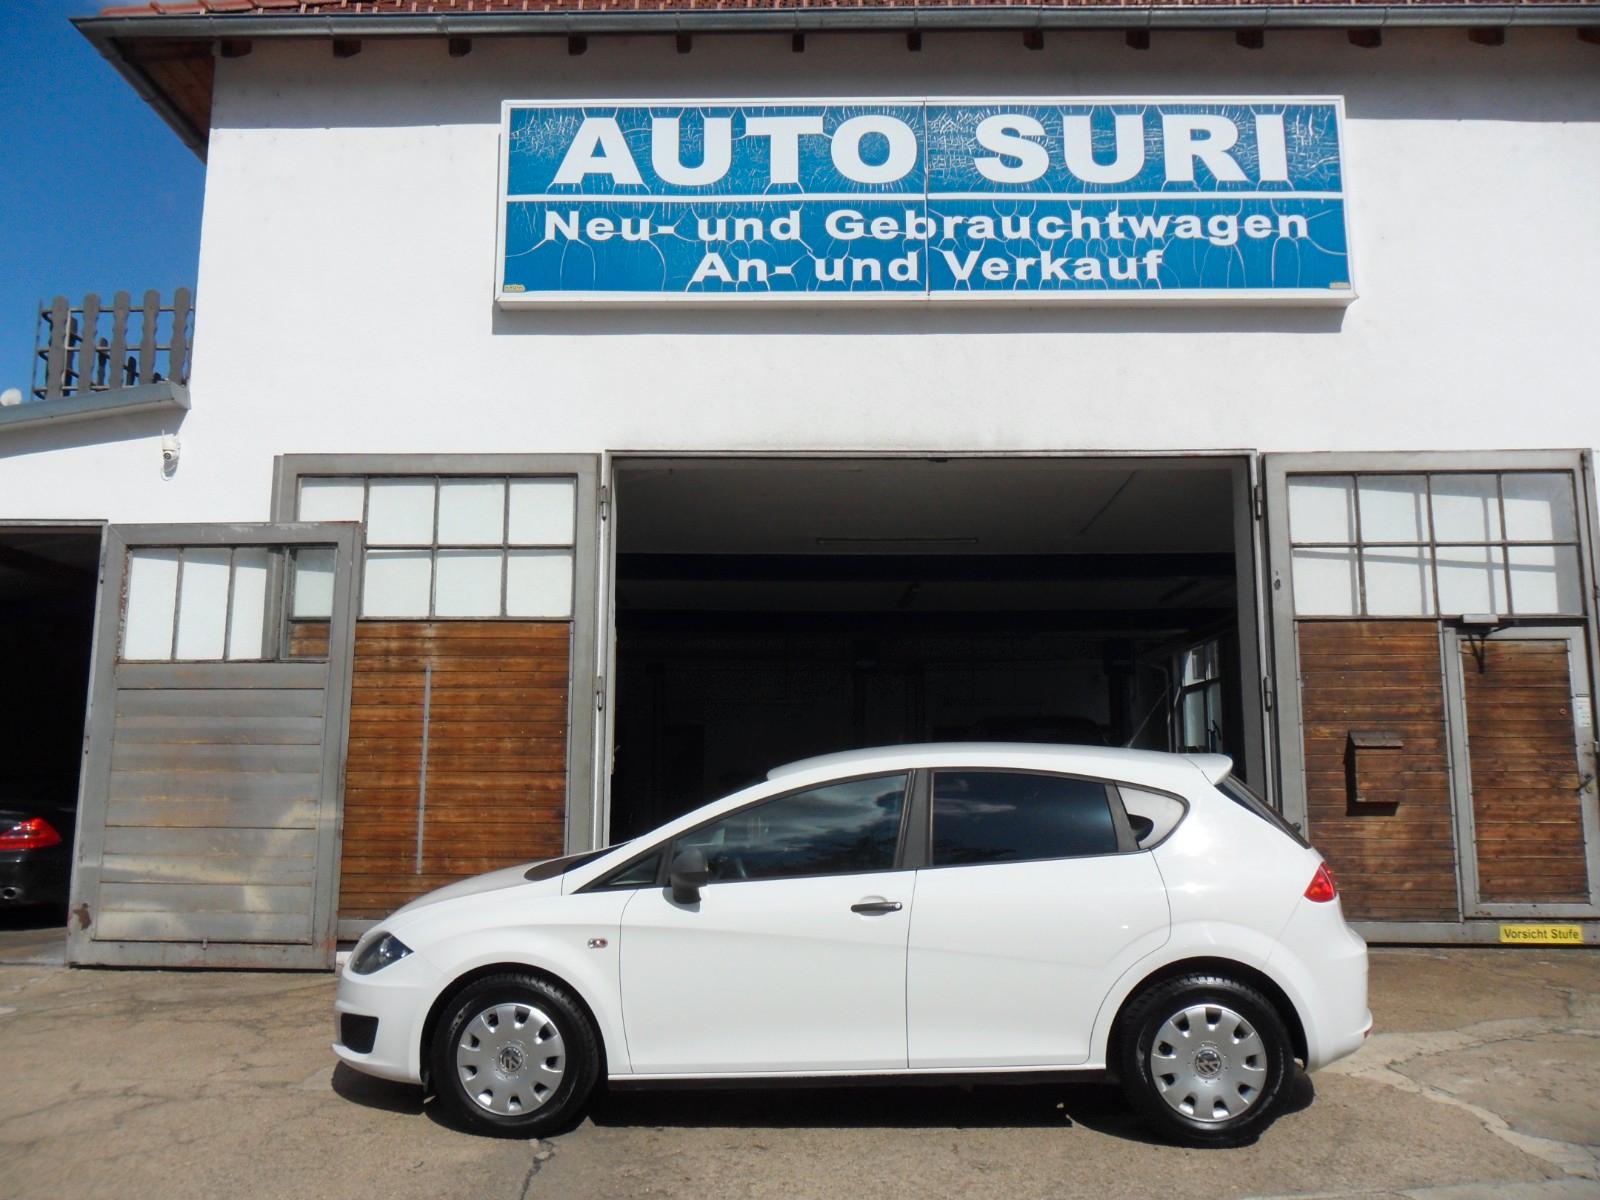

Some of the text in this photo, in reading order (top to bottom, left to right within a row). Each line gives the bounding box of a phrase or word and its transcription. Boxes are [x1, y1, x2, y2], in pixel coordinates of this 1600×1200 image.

[553, 114, 1290, 186] AUTO SURI
[544, 209, 1308, 246] Neu- und Gebrauchtwagen
[691, 250, 1163, 282] An- und Verkauf
[1504, 928, 1579, 939] Vorsicht Stufe
